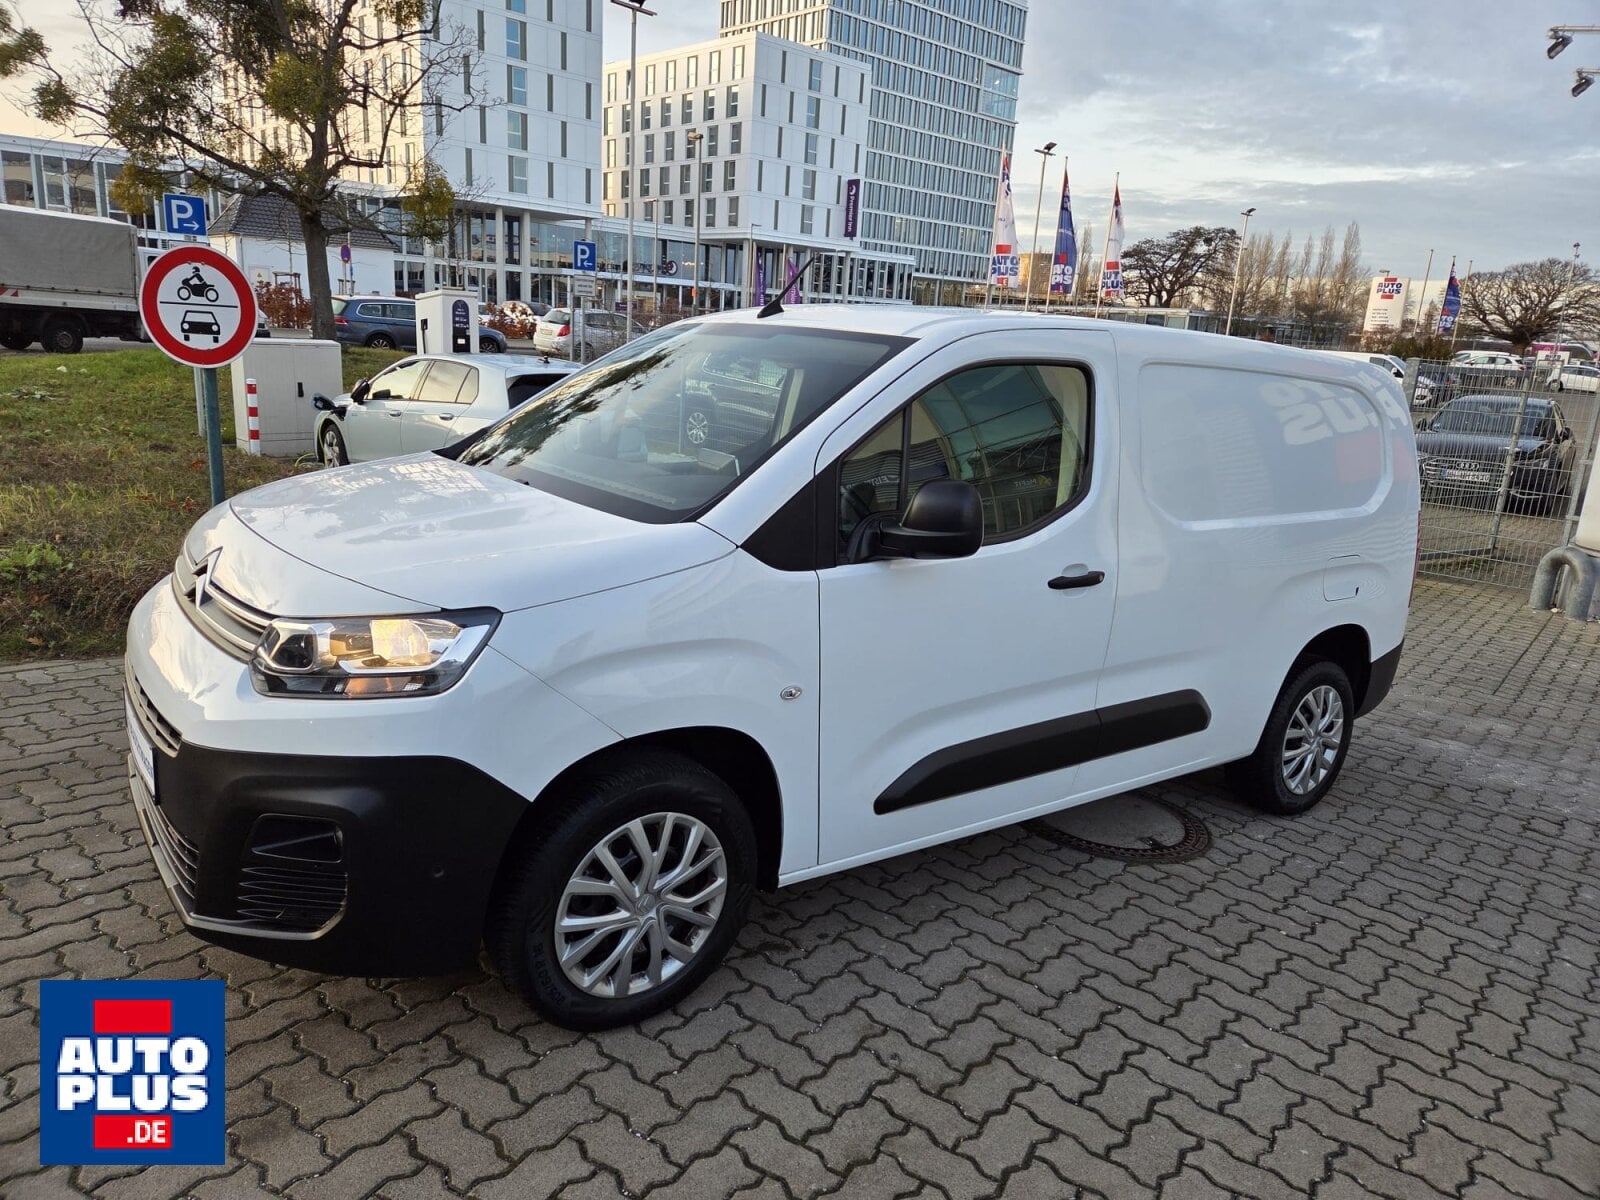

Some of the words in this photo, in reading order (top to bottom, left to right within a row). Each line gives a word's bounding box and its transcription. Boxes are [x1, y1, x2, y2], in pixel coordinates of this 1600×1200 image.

[171, 199, 193, 229] P
[577, 245, 590, 267] P
[992, 255, 1018, 265] AUTO
